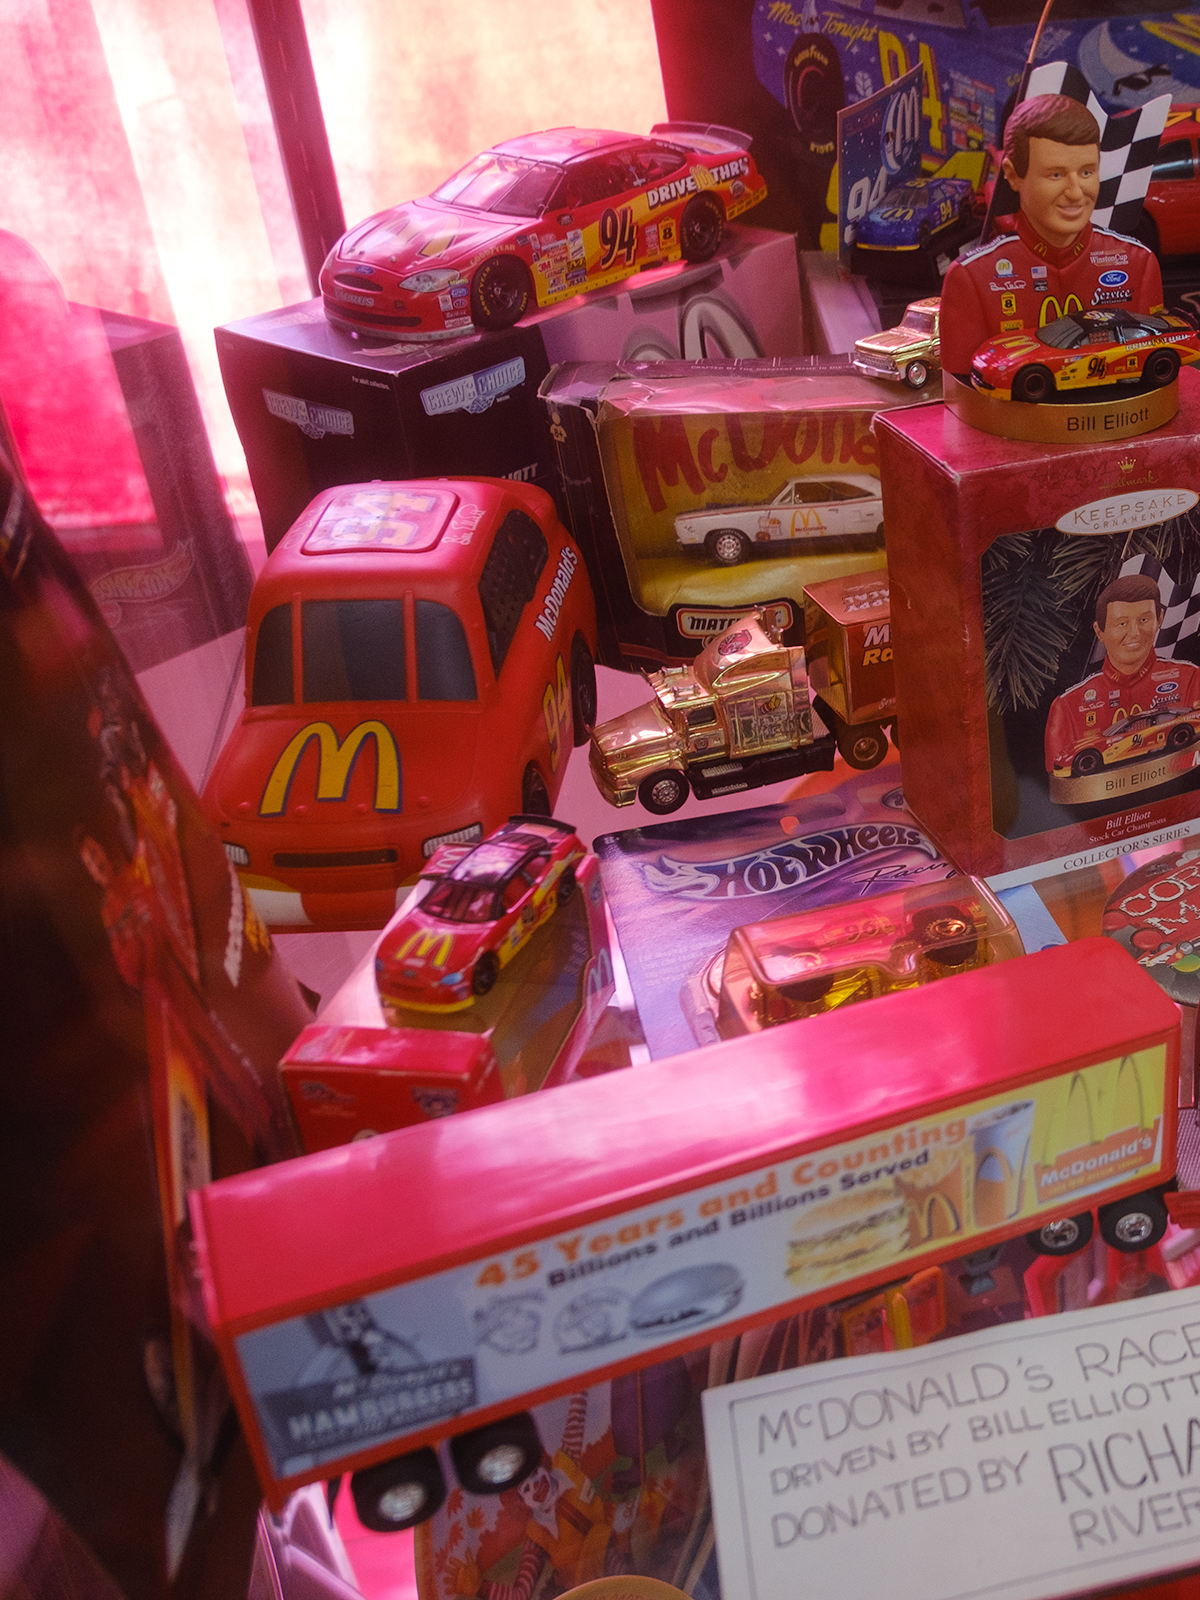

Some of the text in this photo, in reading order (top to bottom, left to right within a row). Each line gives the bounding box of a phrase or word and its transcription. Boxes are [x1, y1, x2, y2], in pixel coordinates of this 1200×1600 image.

[767, 1, 879, 51] Mac Tonight
[647, 176, 695, 207] DRIVE
[940, 200, 952, 222] 94
[601, 208, 638, 270] 94
[966, 234, 1006, 258] McDonald's
[1105, 273, 1122, 283] Ford
[1004, 298, 1014, 309] 8
[1091, 287, 1132, 306] Service
[476, 362, 525, 394] CHOICE
[1086, 354, 1109, 379] 94
[308, 407, 352, 430] CHOICE
[1066, 407, 1150, 433] Bill Elliott
[1098, 472, 1159, 490] Hallmark
[1073, 492, 1188, 526] KEEPSAKE
[1092, 510, 1166, 532] ORNAMENT
[794, 525, 827, 534] McDonald's
[534, 546, 578, 642] McDonald's
[542, 651, 571, 774] 94
[1131, 733, 1144, 747] 94
[1105, 766, 1167, 793] Bill Elliott
[1088, 816, 1167, 845] Stock Car Champions
[1105, 810, 1152, 831] Bill Elliott
[1062, 837, 1149, 872] COLLECTOR'S
[1151, 825, 1191, 848] SERIES
[704, 852, 806, 898] HOT
[1040, 1133, 1153, 1188] McDonald's
[474, 1114, 970, 1290] 45 Years and Counting
[547, 1149, 932, 1289] Billions and Billions Served
[286, 1376, 475, 1442] HAMBURGERS
[770, 1435, 898, 1498] DRIVEN
[905, 1421, 953, 1461] BY
[967, 1403, 1046, 1445] BILL
[771, 1462, 979, 1551] DONATED
[978, 1453, 1032, 1497] BY
